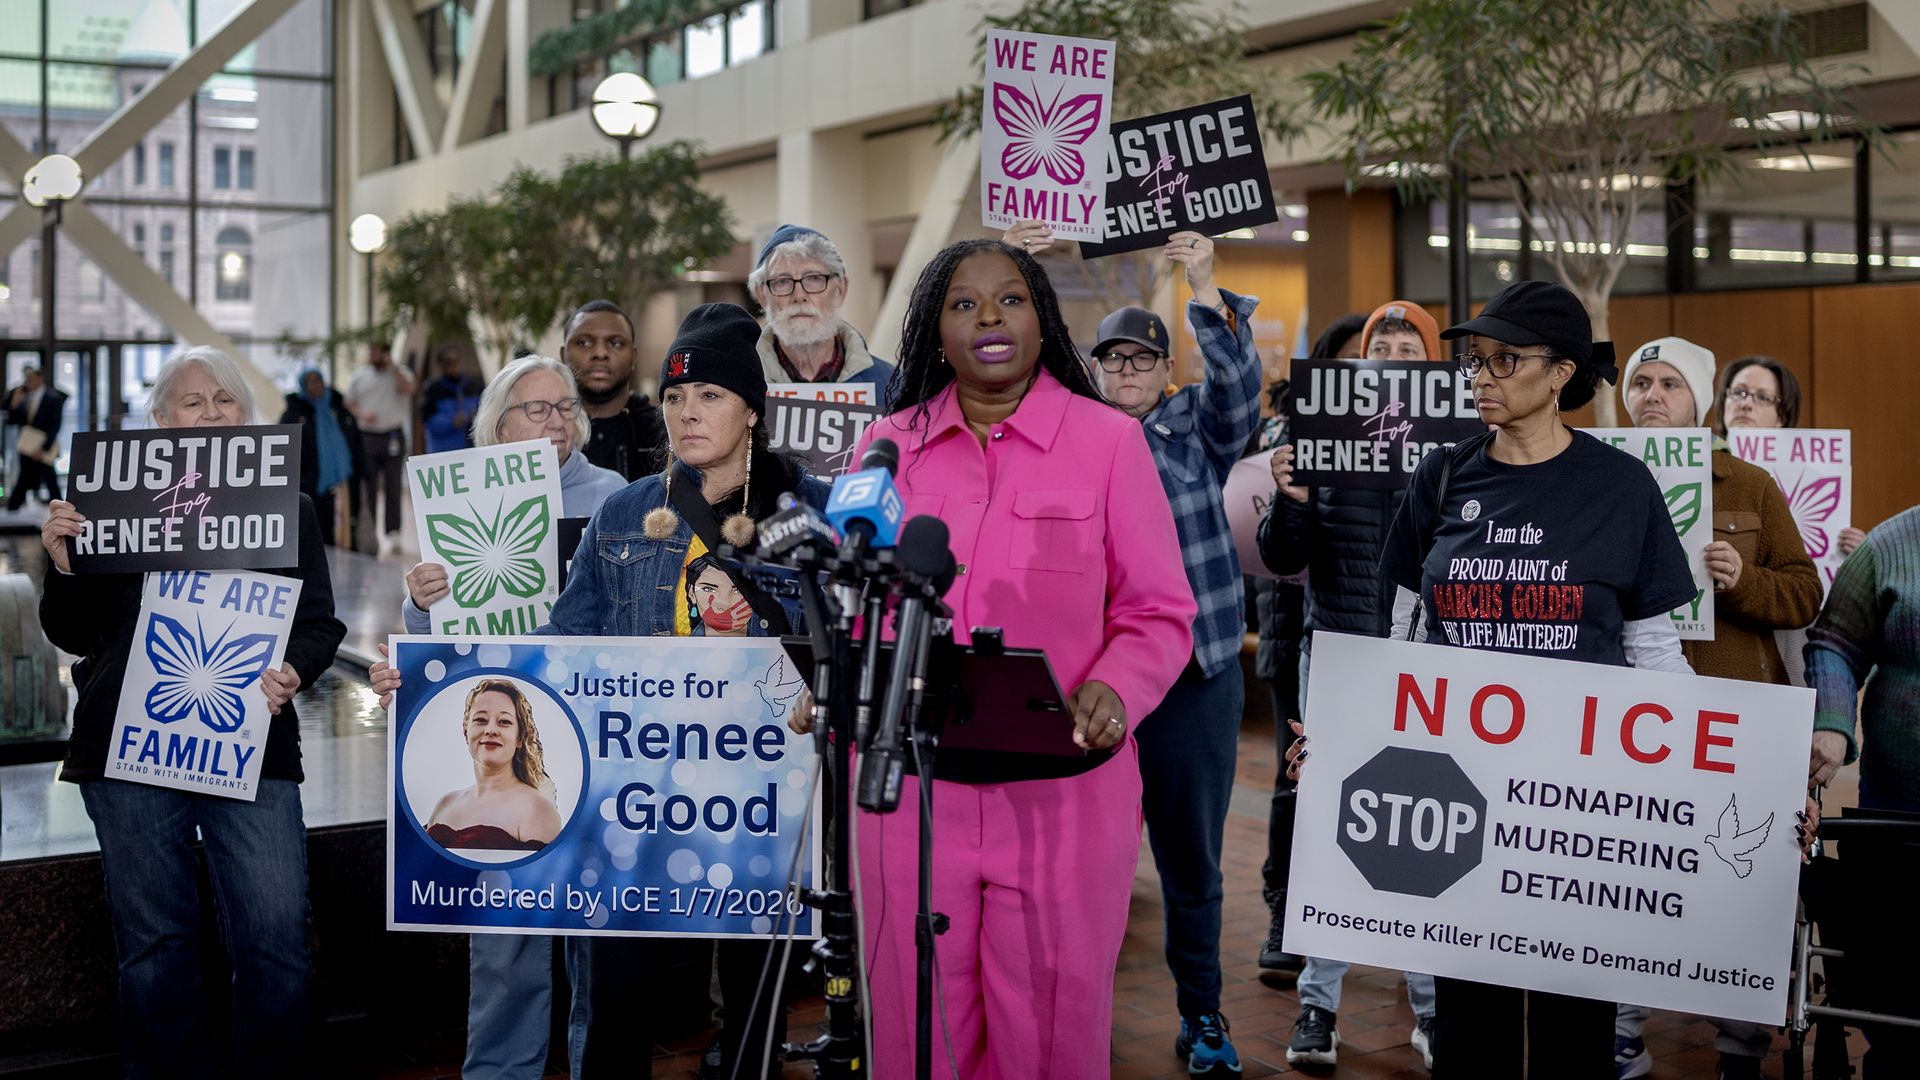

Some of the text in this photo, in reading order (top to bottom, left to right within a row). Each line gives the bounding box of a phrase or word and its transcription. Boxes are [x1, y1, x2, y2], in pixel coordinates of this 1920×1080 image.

[994, 37, 1108, 80] WE ARE
[987, 182, 1098, 225] FAMILY
[989, 213, 1012, 225] STAND
[1103, 178, 1263, 240] ENEE GOOD
[1295, 367, 1480, 419] JUSTICE
[75, 434, 290, 493] JUSTICE
[1296, 438, 1391, 473] RENEE
[1642, 436, 1704, 467] ARE
[1736, 435, 1844, 463] WE ARE
[415, 449, 546, 499] WE ARE
[75, 513, 285, 556] RENEE GOOD
[1485, 519, 1544, 545] I am the
[1448, 557, 1568, 582] PROUD AUNT of
[158, 570, 292, 620] WE ARE
[1432, 582, 1585, 621] MARCUS GOLDEN
[1461, 622, 1494, 648] LIFE
[1494, 622, 1578, 651] MATTERED!
[563, 671, 729, 699] Justice for
[599, 710, 786, 762] Renee
[1393, 672, 1740, 774] NO ICE
[117, 724, 256, 779] FAMILY
[115, 761, 249, 791] STAND WITH IMMIGRANTS
[615, 781, 779, 835] Good
[1346, 788, 1477, 855] STOP
[1506, 777, 1696, 827] KIDNAPING
[1493, 822, 1700, 874] MURDERING
[411, 879, 804, 918] Murdered by ICE 1/7/2026
[1500, 869, 1683, 919] DETAINING
[1302, 904, 1416, 940] Prosecute
[1422, 921, 1484, 949] Killer
[1582, 945, 1683, 981] Demand
[1687, 960, 1776, 992] Justice
